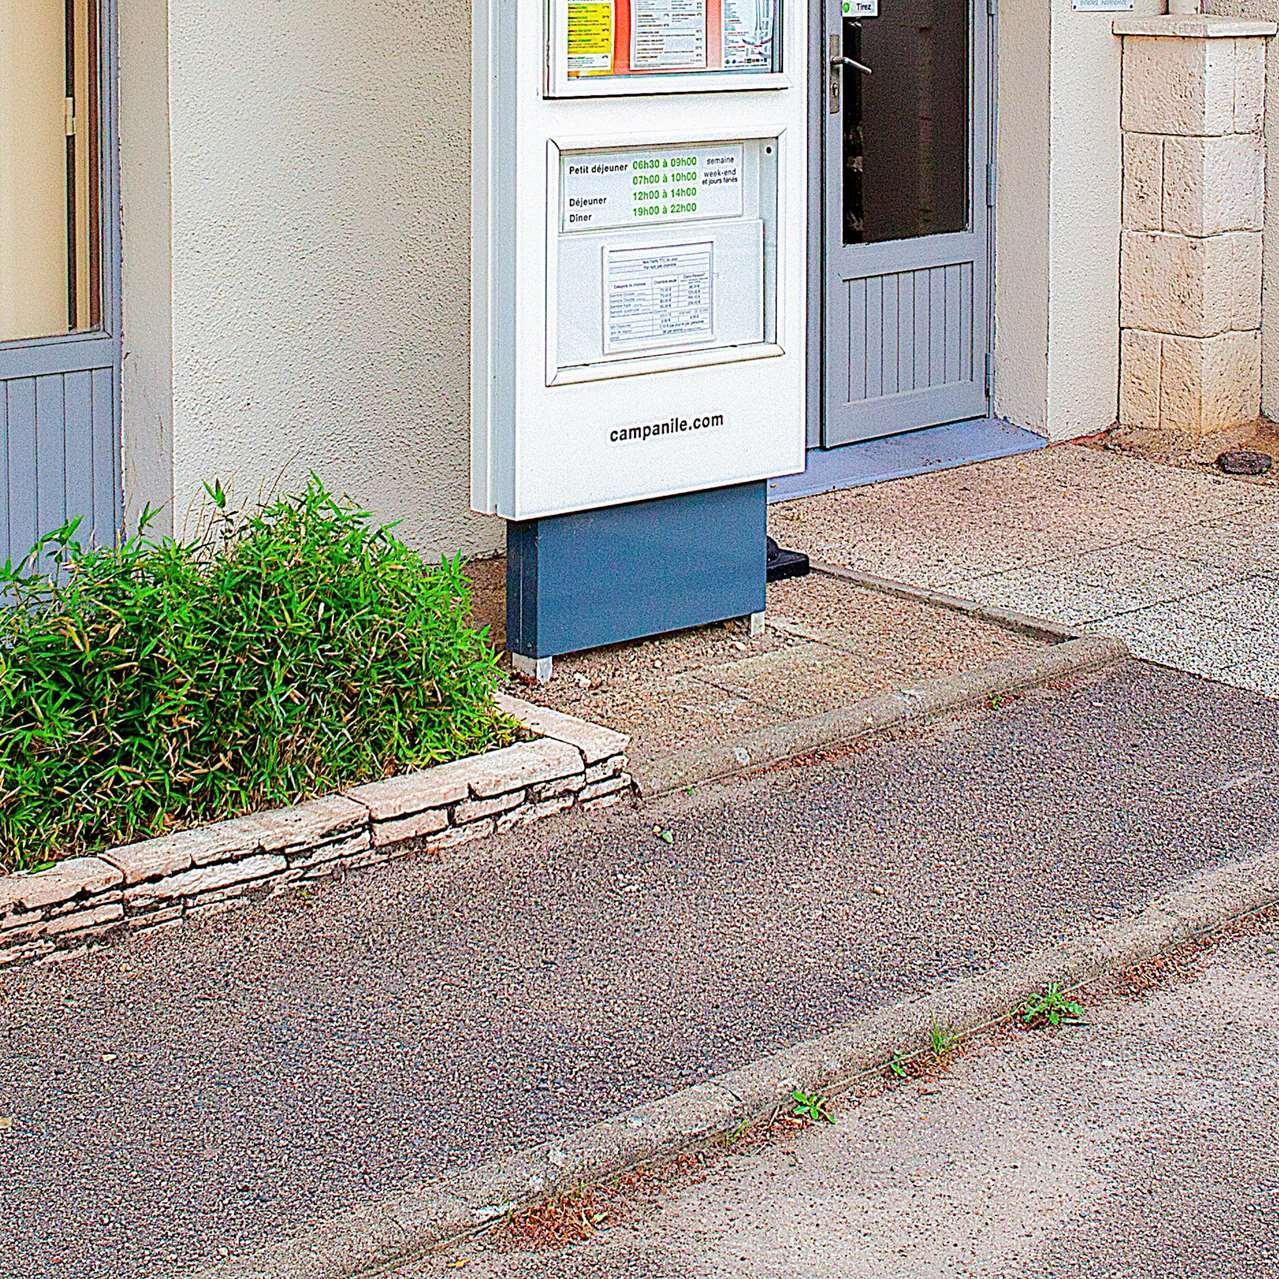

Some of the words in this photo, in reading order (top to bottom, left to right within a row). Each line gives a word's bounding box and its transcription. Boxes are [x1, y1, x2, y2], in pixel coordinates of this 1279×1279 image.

[632, 160, 660, 170] 06h30
[662, 159, 668, 169] à
[670, 156, 697, 167] 09h00
[706, 156, 735, 166] semaine
[569, 165, 589, 175] Petit
[591, 163, 628, 175] déjeuner
[704, 168, 737, 178] week-end
[632, 175, 660, 185] 07h00
[662, 173, 668, 183] à
[671, 171, 697, 182] 10h00
[632, 190, 660, 201] 12h00
[662, 189, 668, 198] à
[671, 187, 697, 198] 14h00
[569, 196, 607, 208] Déjeuner
[632, 206, 660, 217] 19h00
[662, 204, 668, 214] à
[670, 202, 697, 213] 22h00
[610, 414, 724, 442] campanile.com
